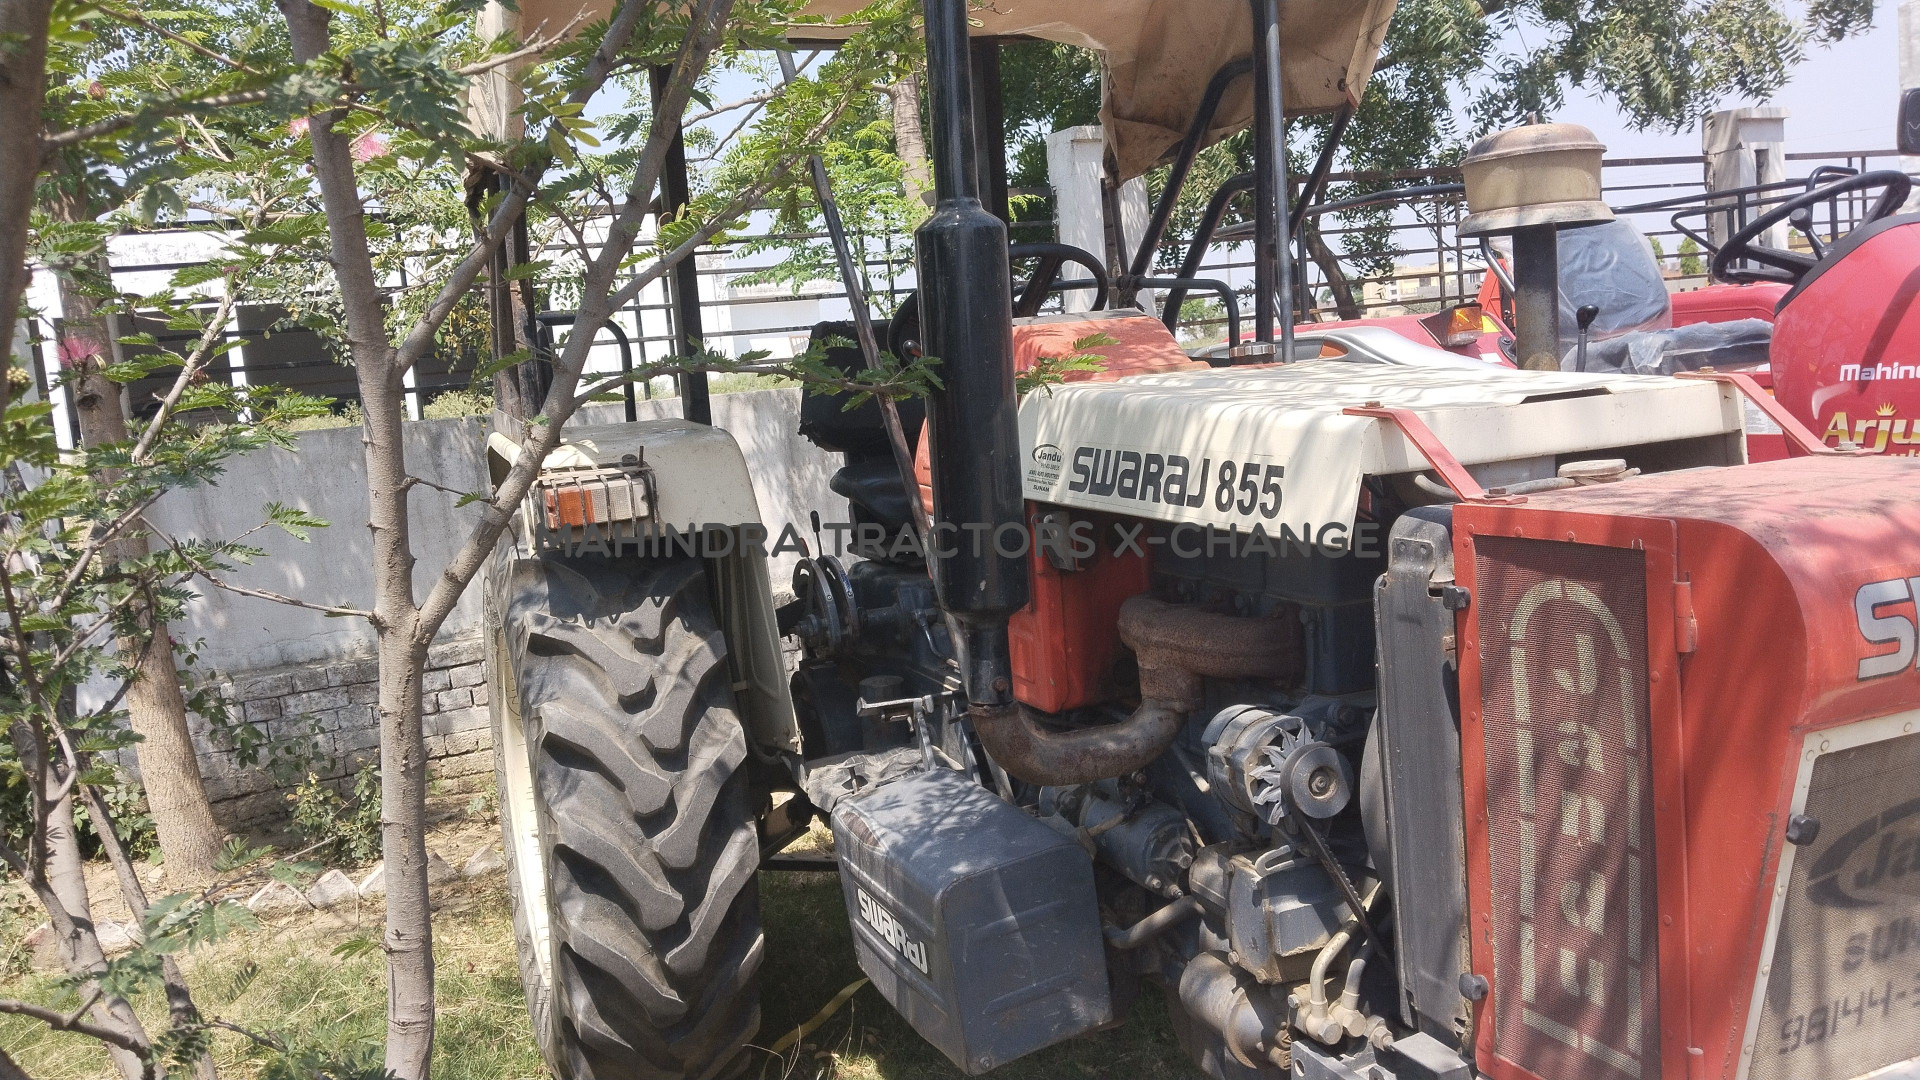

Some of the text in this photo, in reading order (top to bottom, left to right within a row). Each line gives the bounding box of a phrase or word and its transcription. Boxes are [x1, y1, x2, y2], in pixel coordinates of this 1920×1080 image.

[1839, 362, 1920, 382] Mahin
[1038, 450, 1062, 462] Jandu
[1215, 460, 1285, 519] 855
